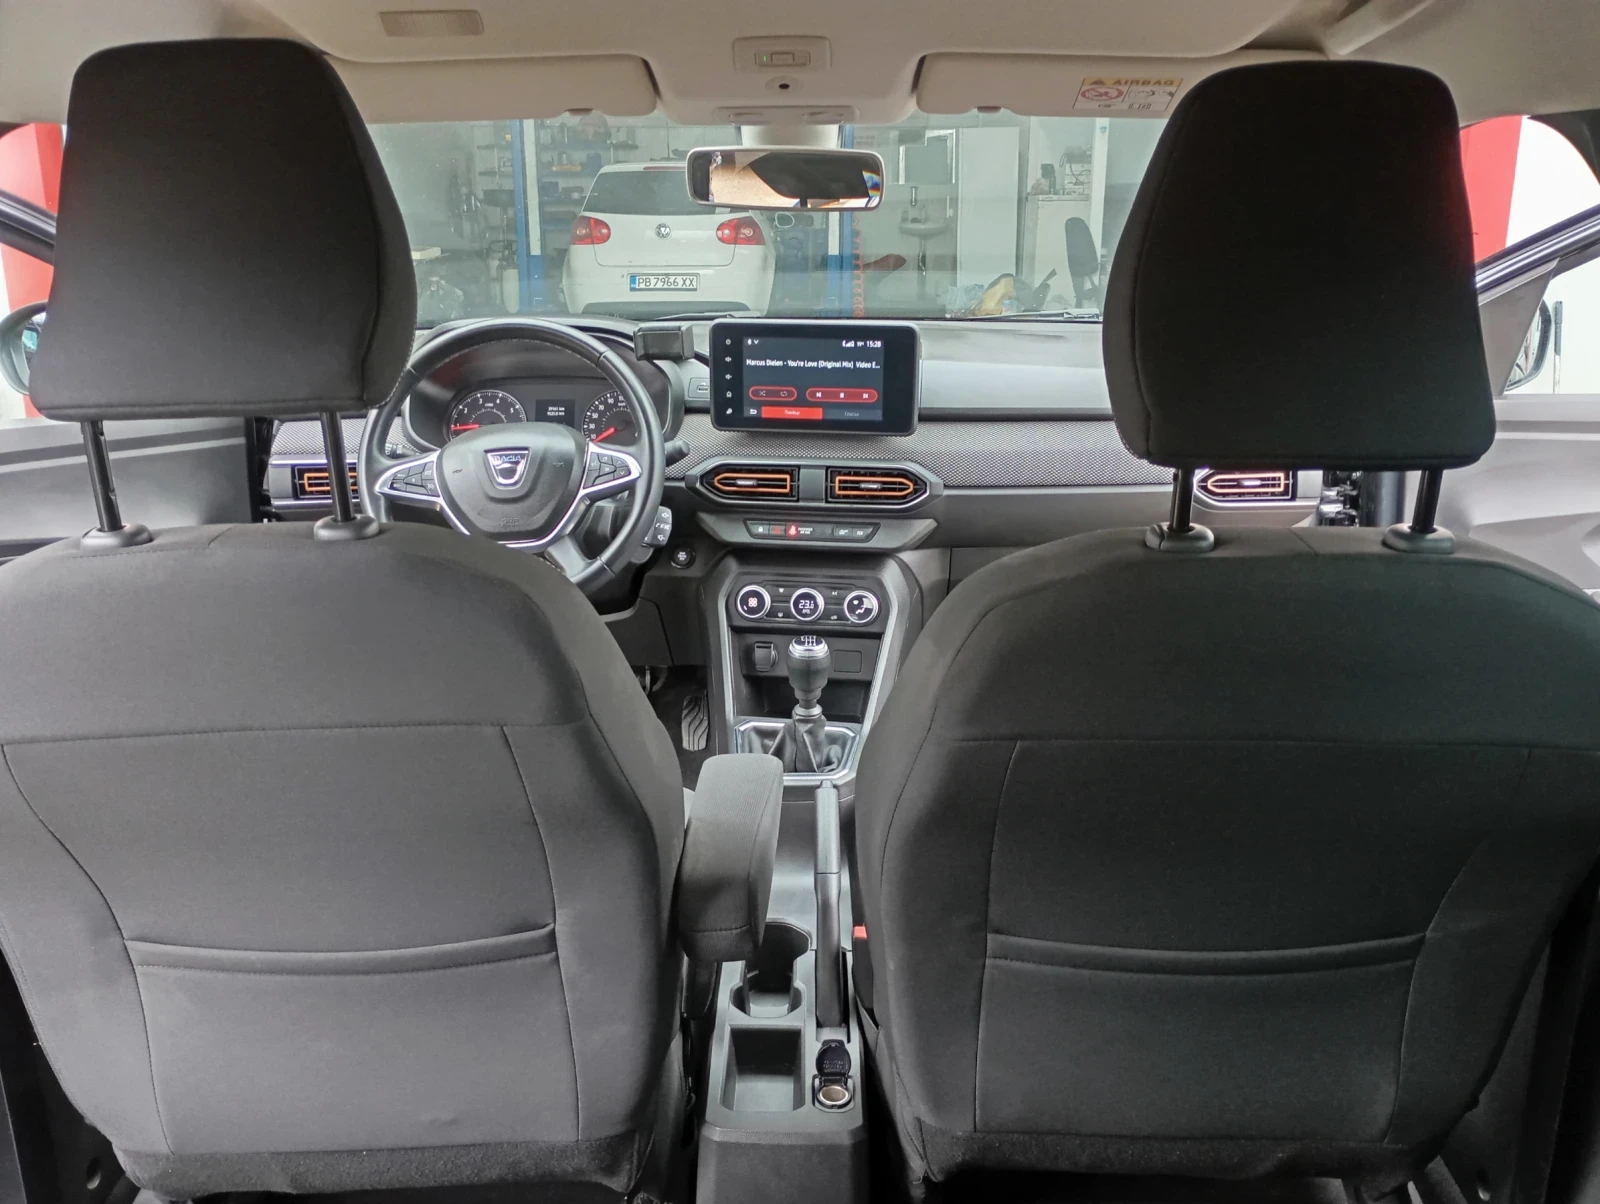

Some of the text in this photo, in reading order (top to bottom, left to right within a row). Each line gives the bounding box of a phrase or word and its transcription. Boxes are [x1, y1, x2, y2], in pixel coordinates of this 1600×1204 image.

[637, 277, 651, 287] PB
[653, 277, 679, 287] 7966
[681, 277, 695, 287] XX
[766, 359, 783, 367] Dielen
[805, 360, 818, 368] Love
[818, 360, 841, 369] (Original
[842, 361, 854, 369] Mix)
[493, 454, 522, 462] DACIA
